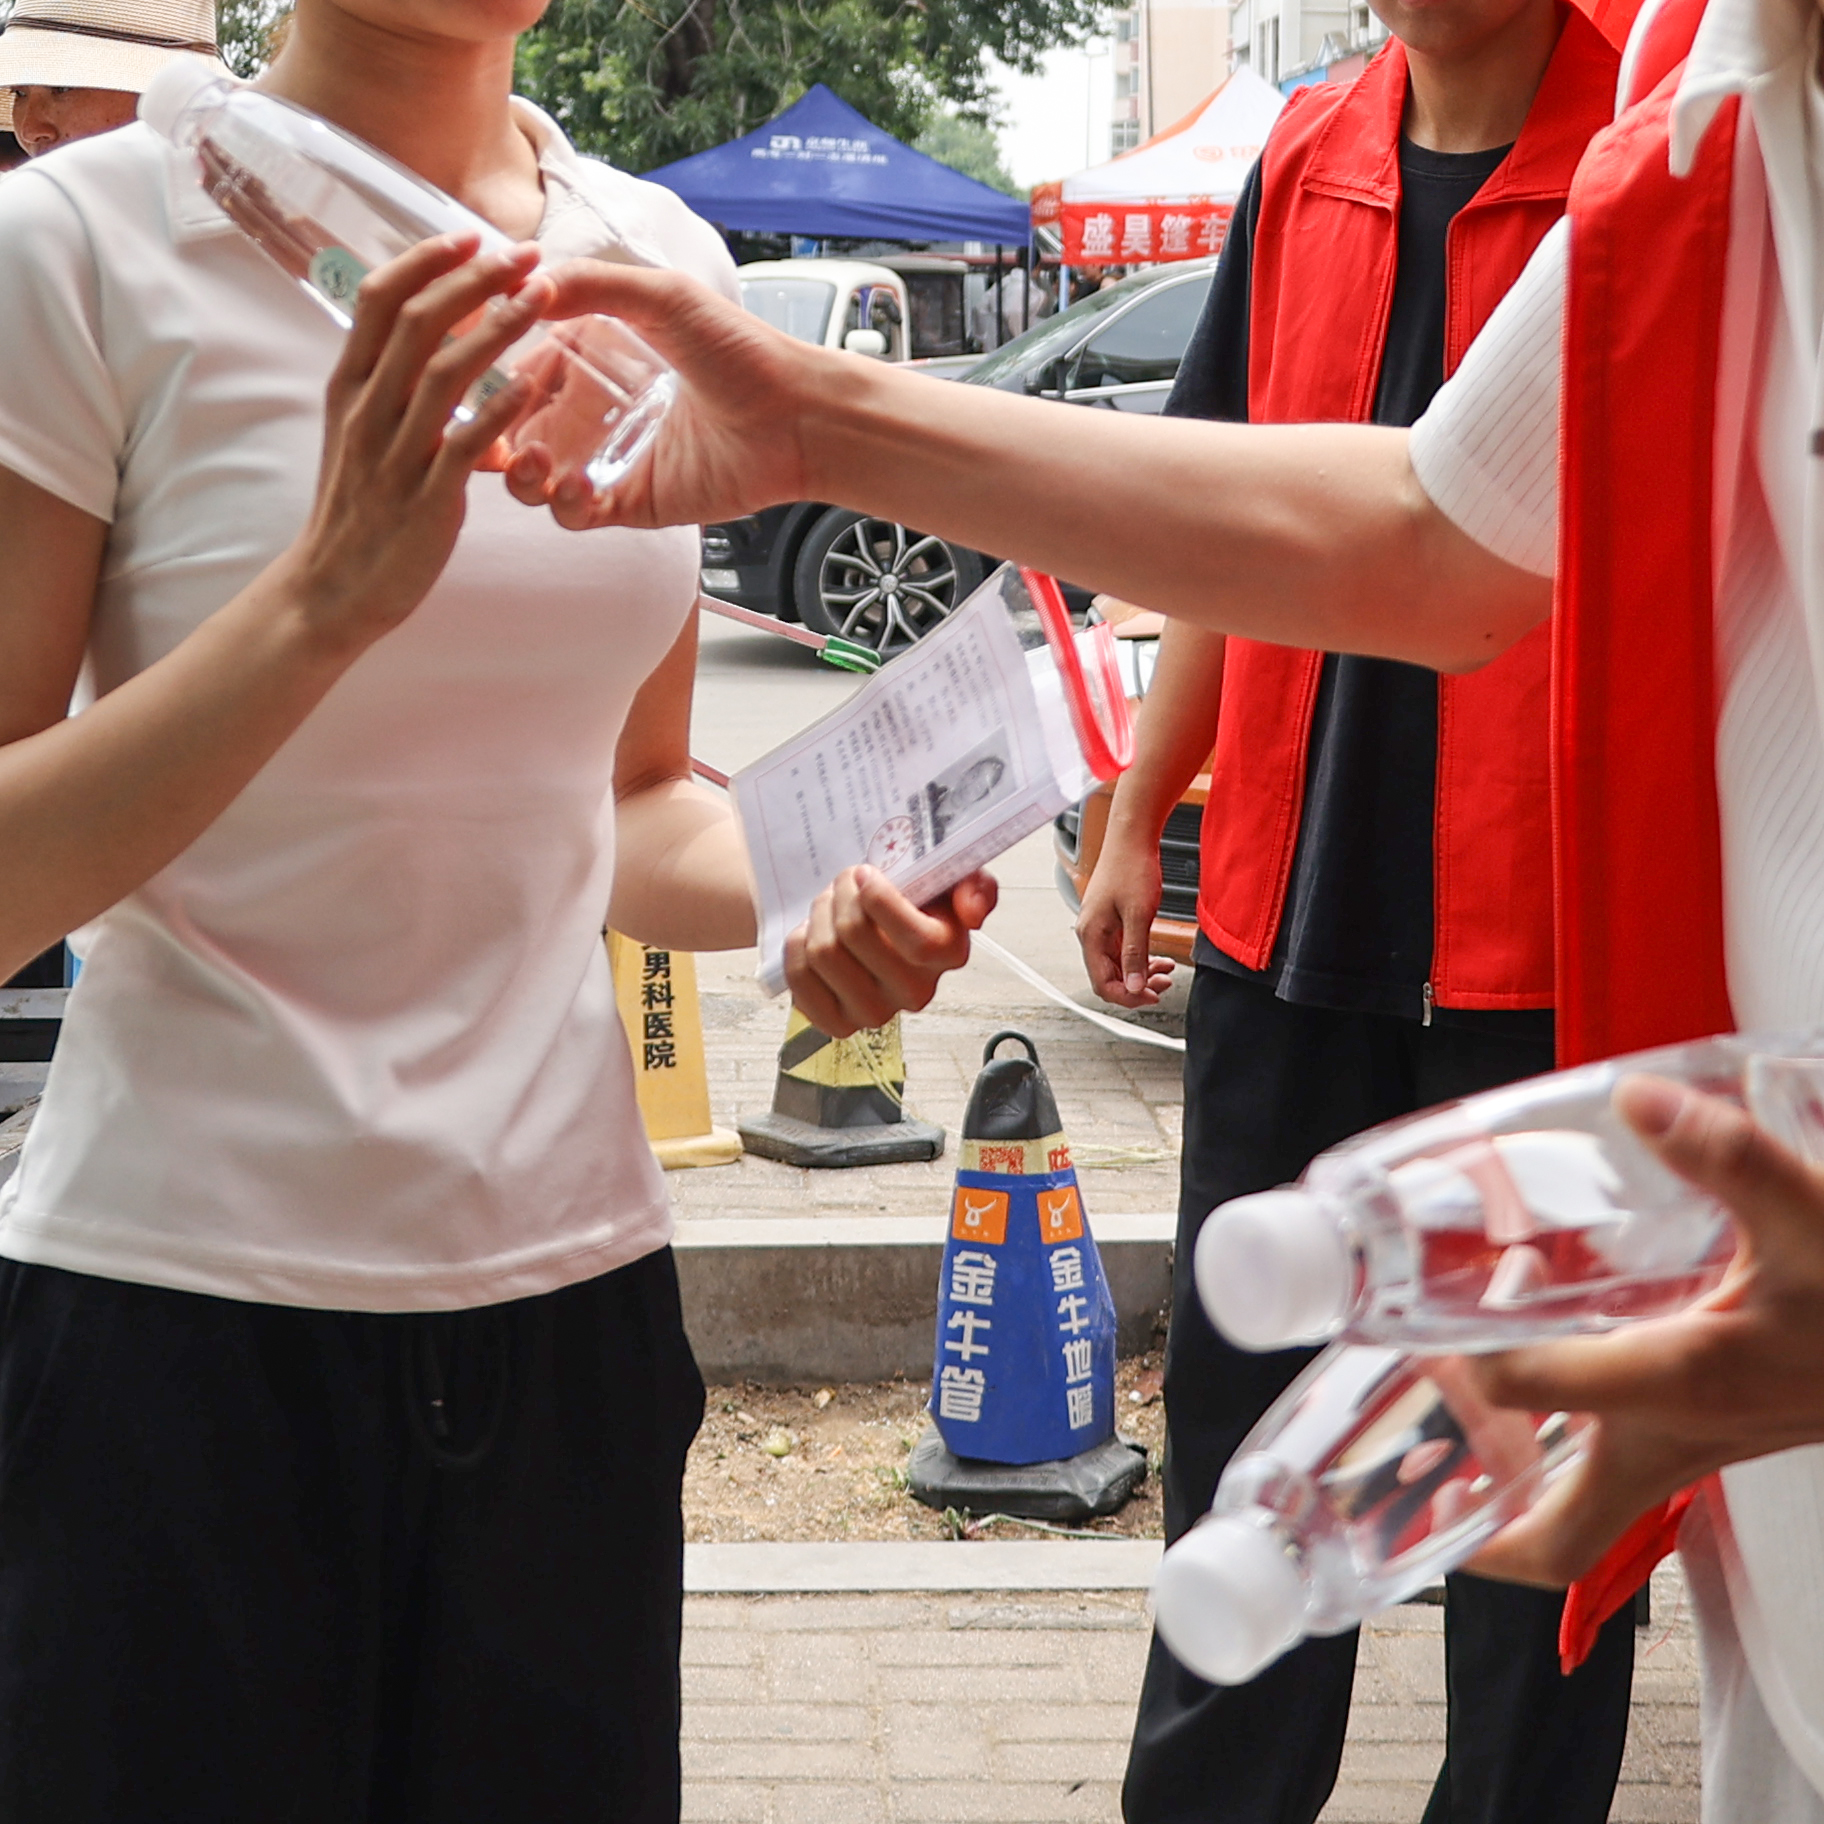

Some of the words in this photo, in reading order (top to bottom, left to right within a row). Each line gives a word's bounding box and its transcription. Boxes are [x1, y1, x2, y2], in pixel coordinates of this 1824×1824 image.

[641, 944, 677, 1071] 男科医院
[939, 1249, 998, 1423] 金牛管
[1049, 1245, 1093, 1430] 金牛地暖
